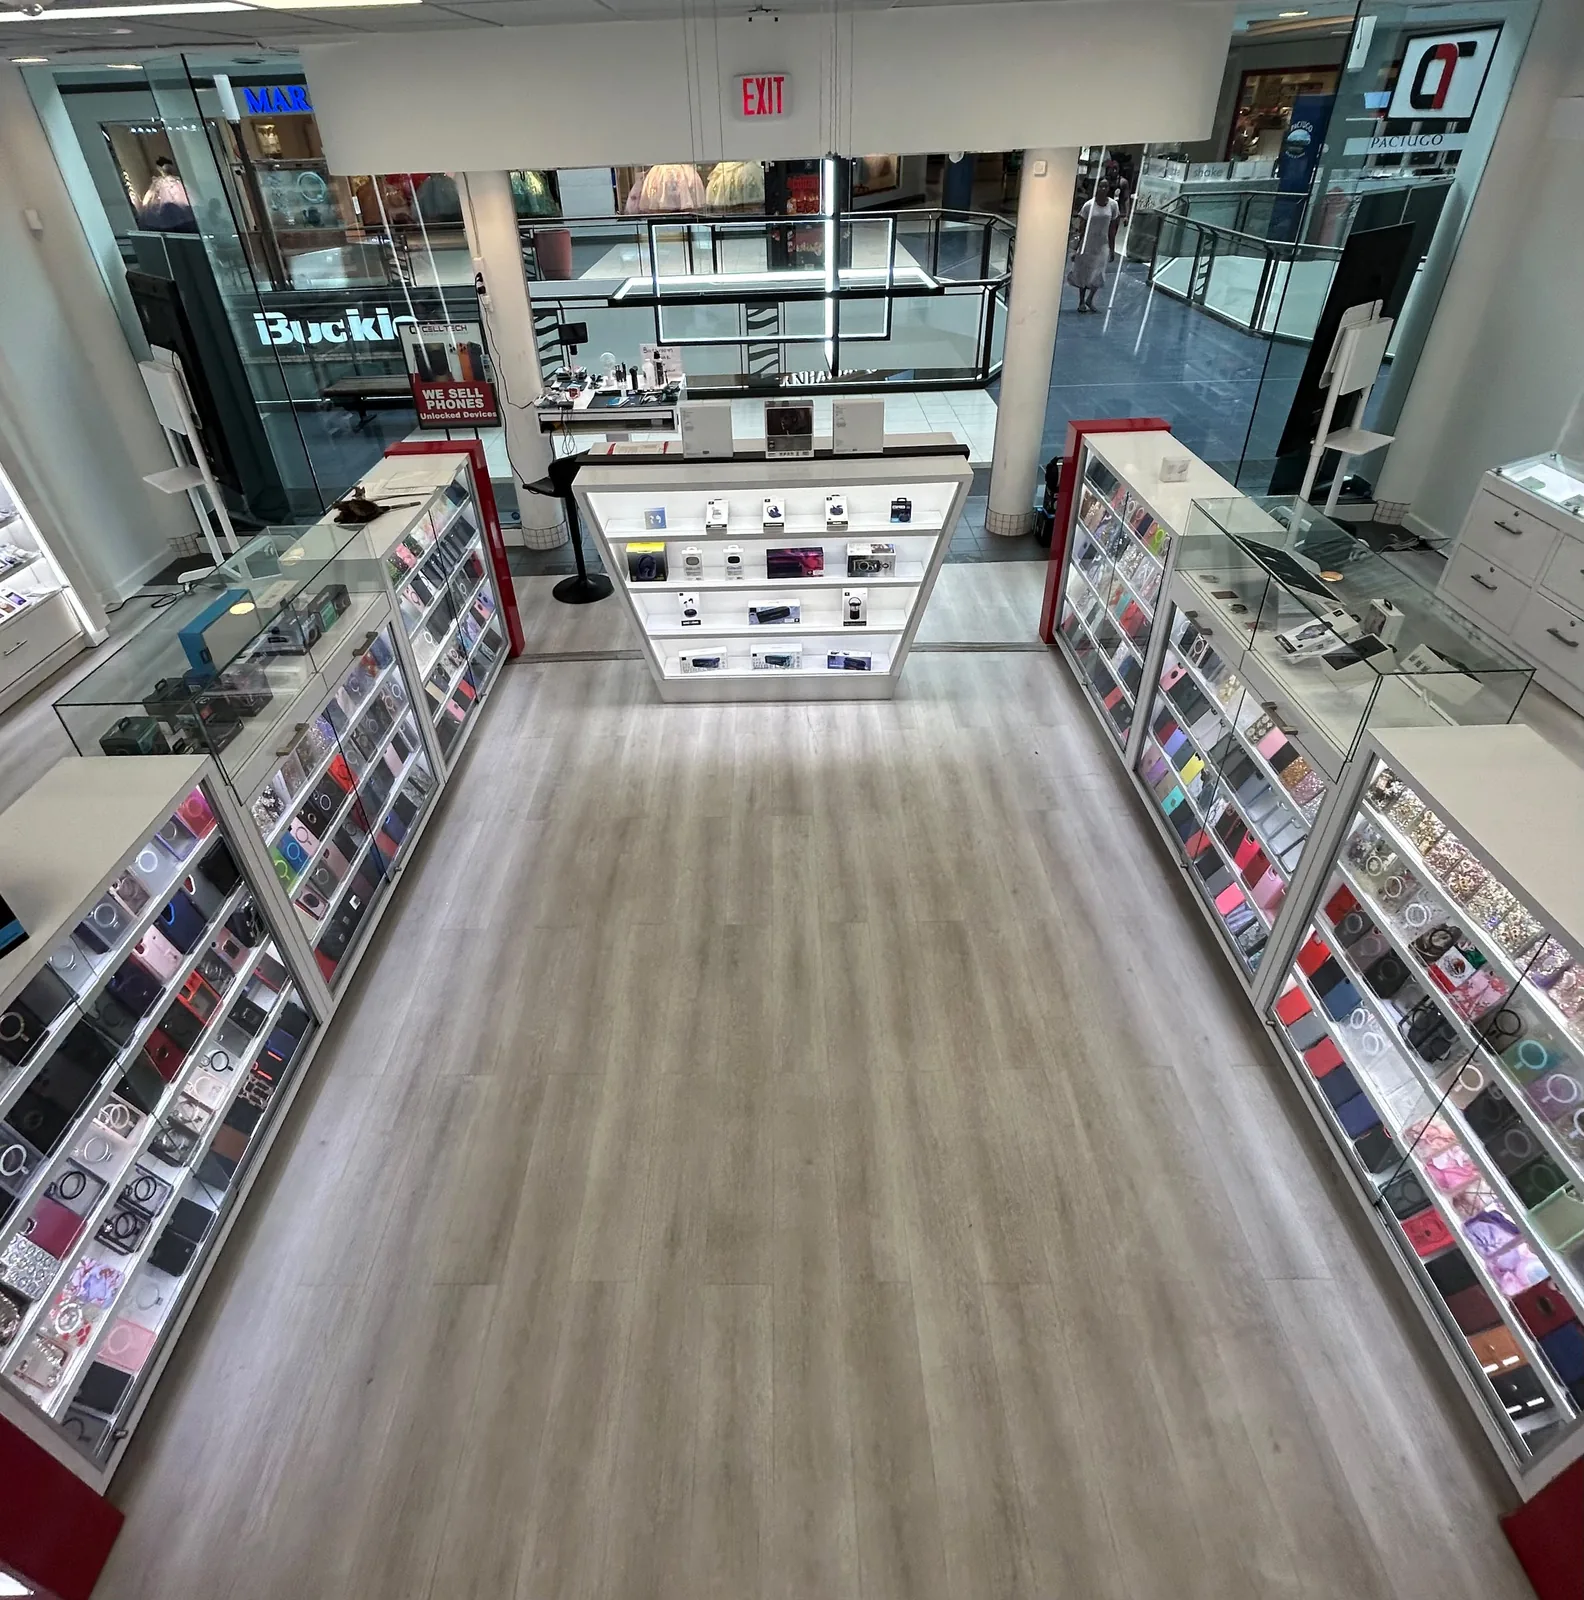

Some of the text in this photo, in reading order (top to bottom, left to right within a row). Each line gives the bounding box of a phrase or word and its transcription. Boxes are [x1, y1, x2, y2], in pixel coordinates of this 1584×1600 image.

[243, 85, 314, 114] MAR
[743, 77, 784, 115] EXIT
[1371, 134, 1444, 148] PACIUGO
[1194, 166, 1223, 177] shake
[253, 307, 418, 345] Buckl
[422, 388, 484, 400] WE SELL
[426, 399, 485, 410] PHONES
[420, 411, 461, 420] Unlocked
